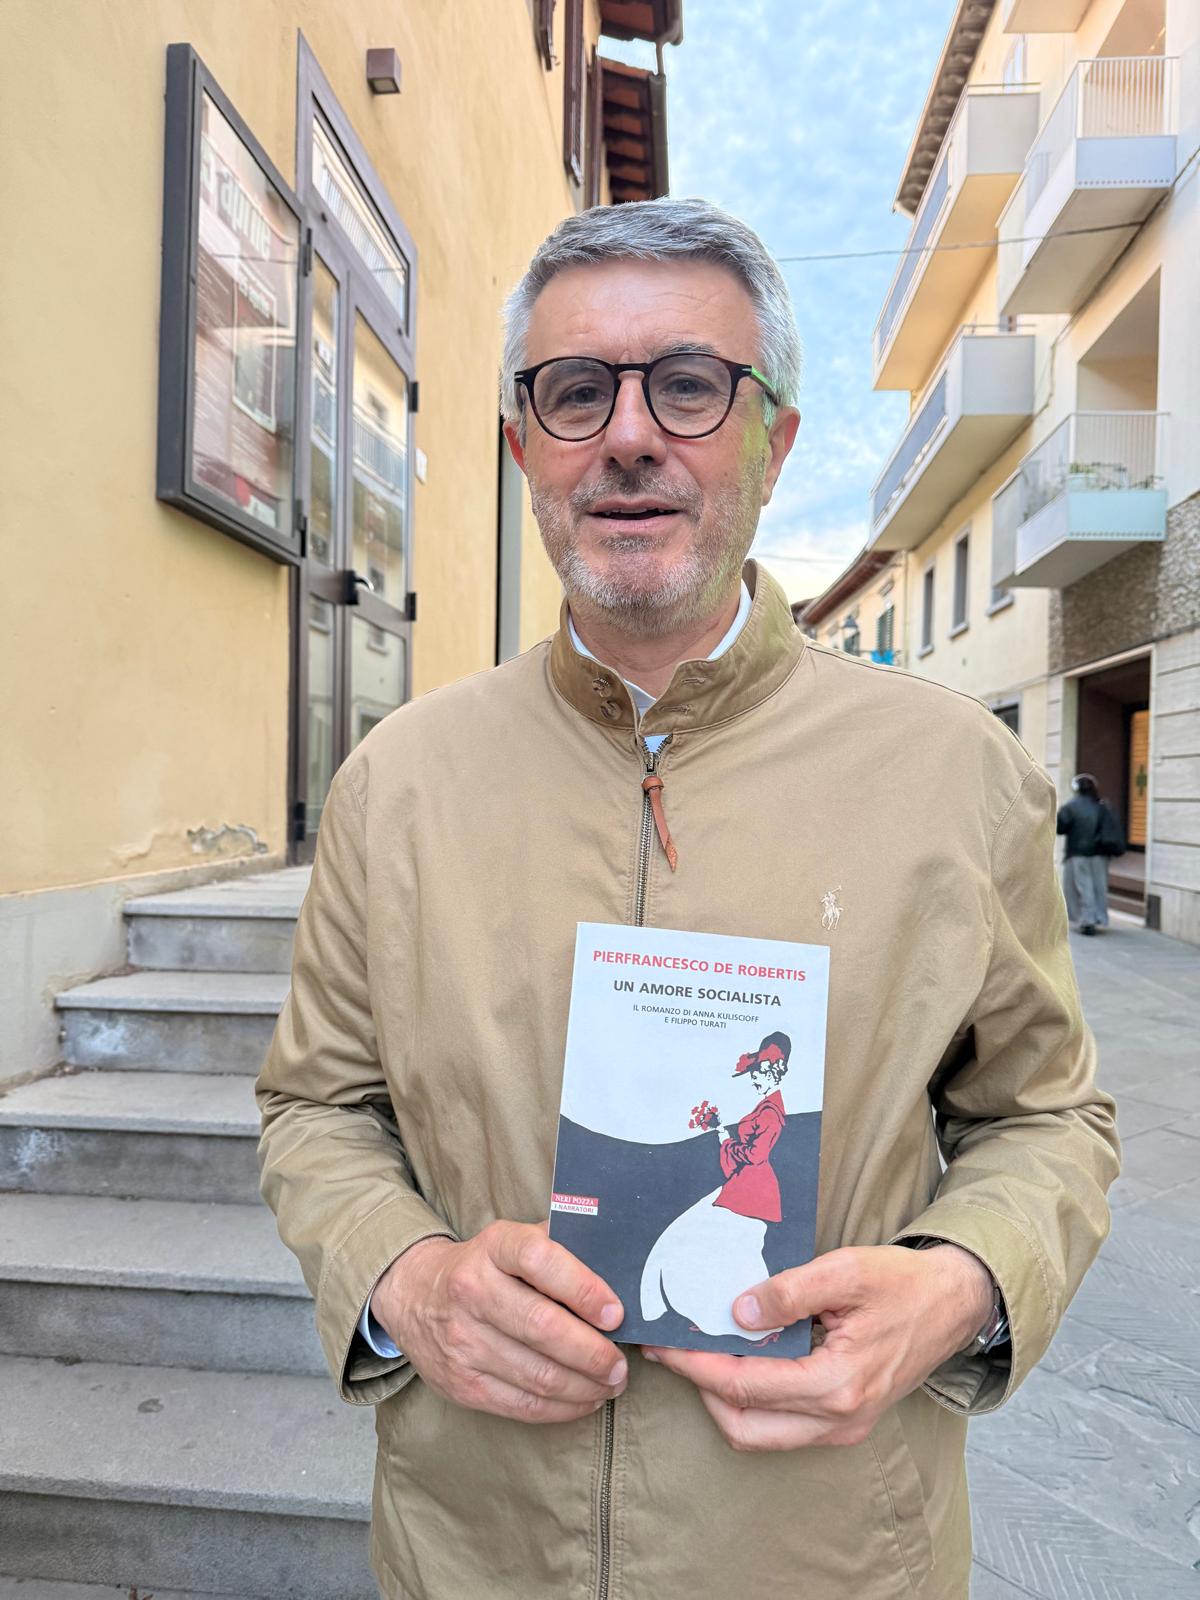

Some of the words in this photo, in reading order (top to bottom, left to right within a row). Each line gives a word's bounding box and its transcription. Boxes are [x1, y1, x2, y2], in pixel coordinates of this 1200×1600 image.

[593, 950, 709, 972] PIERFRANCESCO
[713, 962, 733, 975] DE
[738, 964, 806, 981] ROBERTIS
[613, 980, 635, 993] UN
[639, 982, 693, 998] AMORE
[697, 988, 782, 1007] SOCIALISTA
[633, 1004, 640, 1012] IL
[641, 1005, 681, 1016] ROMANZO
[683, 1009, 691, 1017] DI
[693, 1010, 715, 1019] ANNA
[717, 1012, 760, 1023] KULISCIOFF
[664, 1016, 669, 1024] E
[671, 1017, 698, 1026] FILIPPO
[700, 1019, 727, 1029] TURATI
[555, 1195, 571, 1203] NERI
[572, 1196, 594, 1206] POZZA
[558, 1204, 595, 1214] NARRATORI
